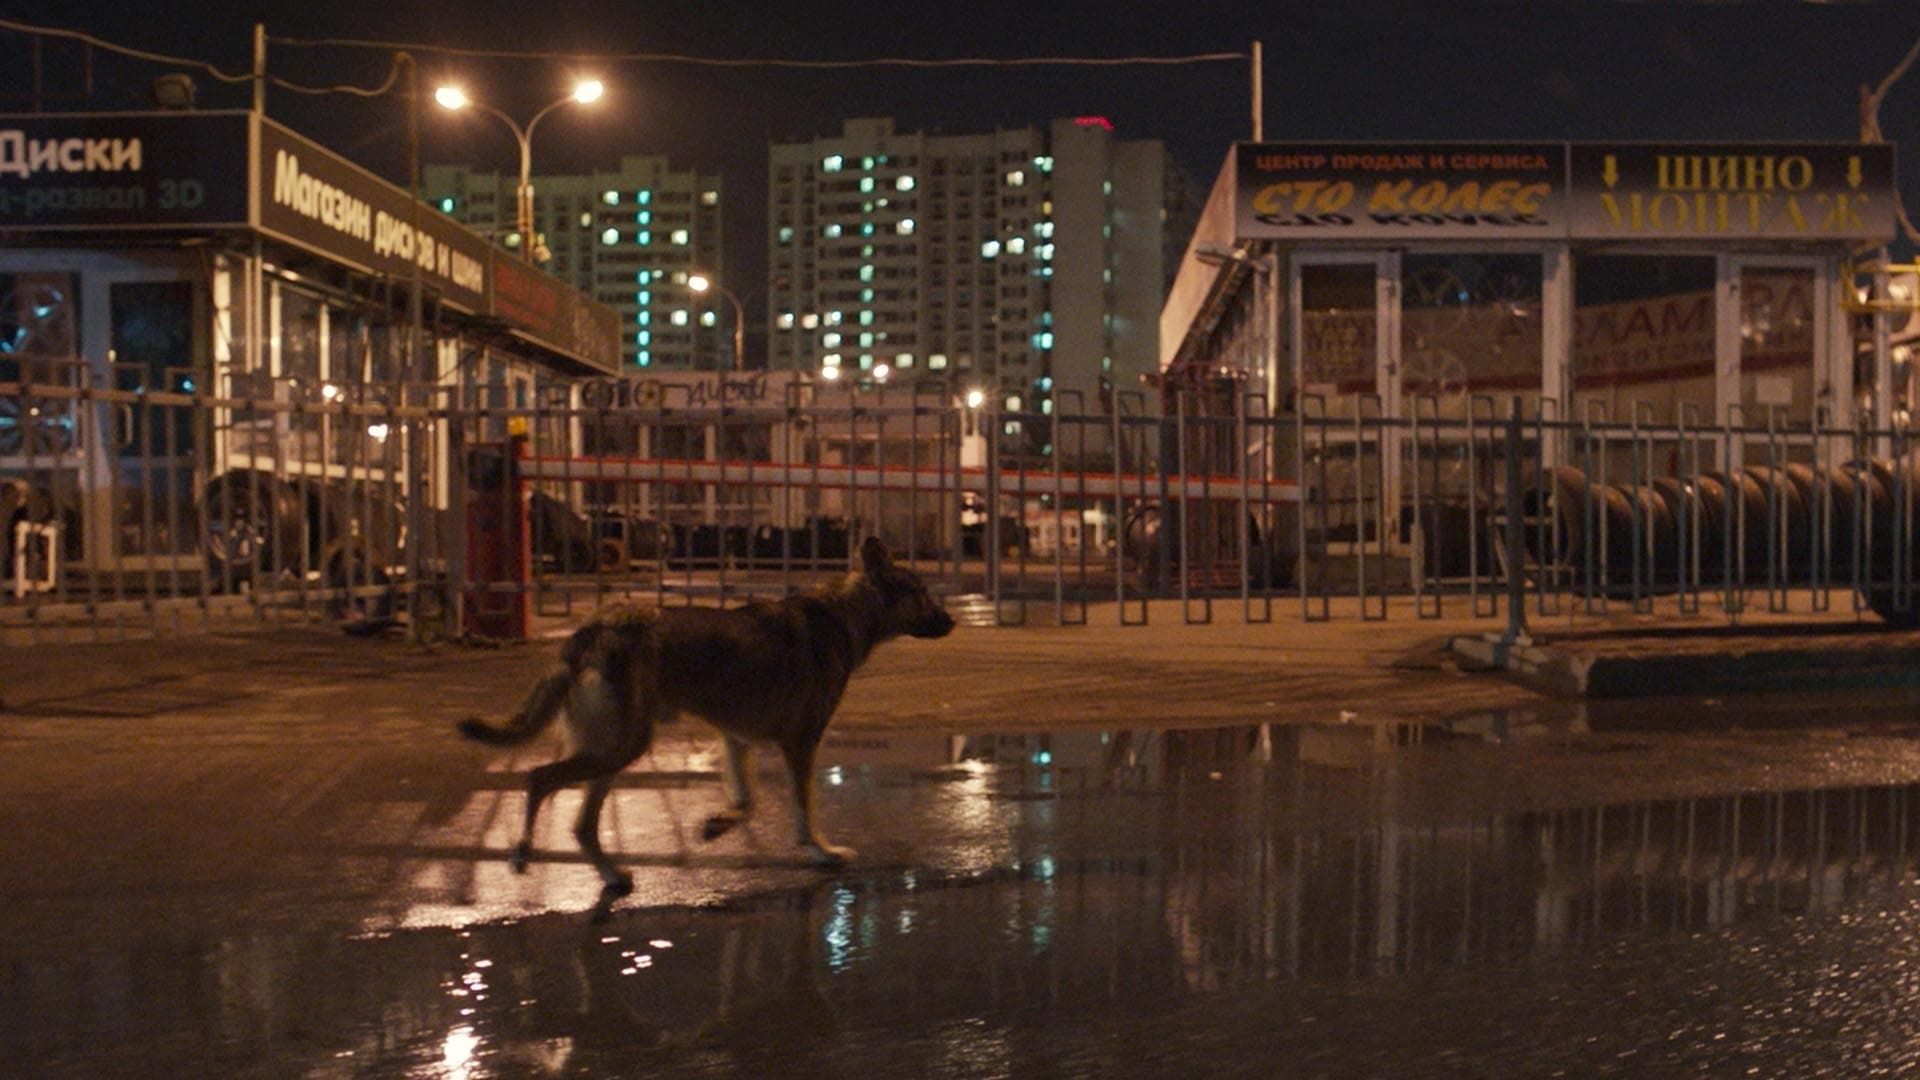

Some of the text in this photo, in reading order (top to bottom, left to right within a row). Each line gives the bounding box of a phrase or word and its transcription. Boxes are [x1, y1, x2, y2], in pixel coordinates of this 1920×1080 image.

[0, 129, 143, 179] Диски
[1256, 154, 1549, 171] ЦЕНТР ПРОДАЖ И СЕРВИСА
[1656, 155, 1813, 190] ШИНО
[157, 178, 205, 210] 3D
[1253, 179, 1553, 214] СТО КОЛЕС
[274, 149, 371, 242] Магазин
[437, 242, 449, 278] и
[1600, 192, 1869, 233] МОНТАЖ
